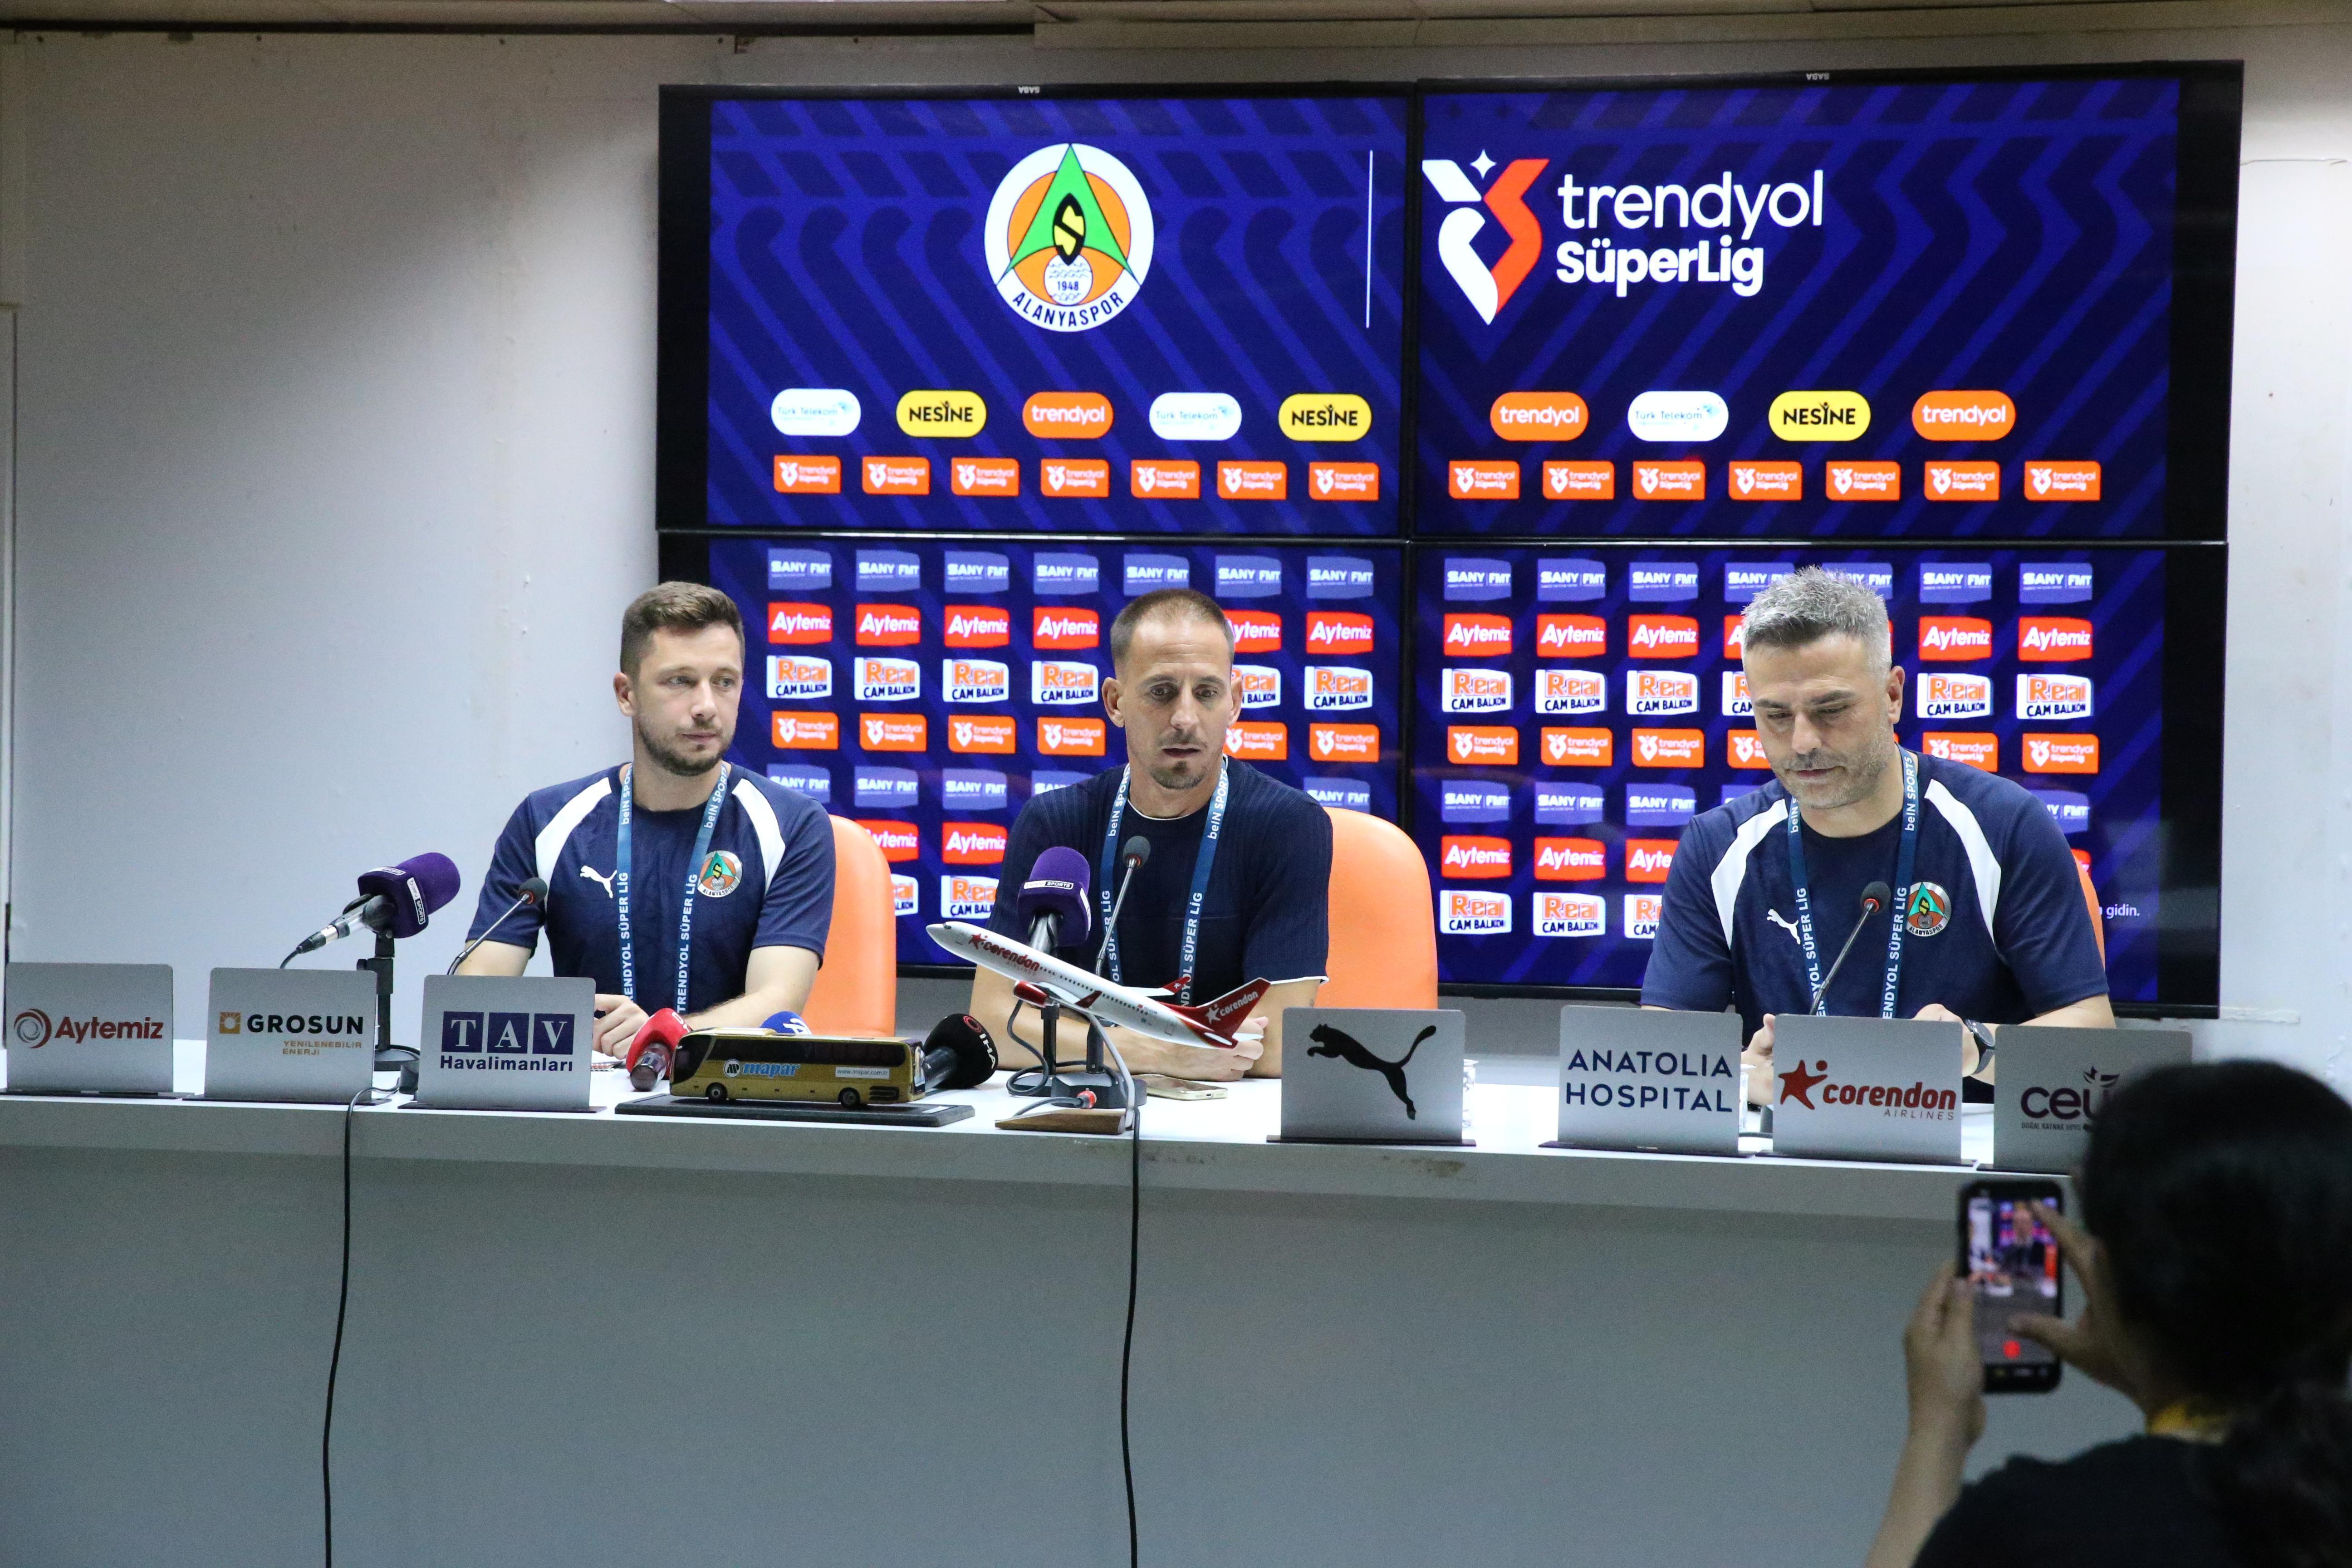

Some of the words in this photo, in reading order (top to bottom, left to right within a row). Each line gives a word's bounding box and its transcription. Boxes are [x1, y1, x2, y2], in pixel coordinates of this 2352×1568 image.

[1558, 170, 1823, 242] trendyol
[1556, 234, 1764, 297] SüperLig
[1057, 281, 1079, 291] 1948
[1012, 292, 1124, 327] ALANYASPOR
[801, 407, 838, 415] Telekom
[1031, 405, 1104, 425] trendyol
[1180, 411, 1218, 420] Telekom
[1500, 406, 1579, 427] trendyol
[1661, 411, 1702, 419] Telekom
[1922, 404, 2006, 426] trendyol
[771, 561, 807, 572] SANY
[859, 562, 894, 573] SANY
[948, 564, 983, 575] SANY
[1037, 565, 1073, 577] SANY
[1219, 568, 1255, 579] SANY
[1310, 569, 1347, 580] SANY
[1448, 571, 1485, 585] SANY
[1541, 571, 1578, 583] SANY
[1632, 572, 1671, 586] SANY
[1923, 573, 1963, 587] SANY
[2023, 573, 2063, 584] SANY
[772, 612, 830, 634] Aytemiz
[859, 613, 918, 636] Aytemiz
[948, 615, 1007, 637] Aytemiz
[1037, 617, 1097, 639] Aytemiz
[1310, 621, 1372, 644] Aytemiz
[1447, 623, 1510, 646] Aytemiz
[1541, 624, 1604, 647] Aytemiz
[1632, 624, 1696, 648] Aytemiz
[1923, 626, 1989, 650] Aytemiz
[2023, 627, 2090, 651] Aytemiz
[776, 685, 797, 696] CAM
[864, 687, 885, 699] CAM
[952, 689, 973, 700] CAM
[1041, 691, 1063, 702] CAM
[1314, 696, 1336, 708] CAM
[1452, 698, 1474, 710] CAM
[1545, 700, 1567, 711] CAM
[1637, 701, 1659, 712] CAM
[1927, 704, 1950, 716] CAM
[2027, 705, 2050, 717] CAM
[712, 765, 727, 803] SPORTS
[1215, 768, 1228, 809] SPORTS
[1907, 757, 1918, 801] SPORTS
[617, 872, 628, 893] LİG
[686, 874, 697, 894] LİG
[1796, 888, 1808, 910] LİG
[1894, 887, 1907, 909] LİG
[618, 897, 630, 939] SÜPER
[680, 898, 694, 941] SÜPER
[2106, 903, 2140, 919] gidin.
[1183, 918, 1197, 962] SÜPER
[1190, 892, 1202, 915] LİG
[1450, 919, 1471, 931] CAM
[1543, 922, 1565, 933] CAM
[1799, 914, 1816, 959] SÜPER
[1888, 913, 1905, 961] SÜPER
[983, 941, 1040, 971] corendon
[676, 944, 689, 1014] TRENDYOL
[1220, 990, 1258, 1017] corendon
[54, 1016, 163, 1044] Aytemiz
[247, 1014, 363, 1034] GROSUN
[451, 1019, 567, 1049] TAV
[441, 1054, 573, 1071] Havalimanları
[743, 1063, 800, 1078] mapar
[1568, 1049, 1732, 1077] ANATOLIA
[1567, 1083, 1732, 1112] HOSPITAL
[1823, 1082, 1956, 1110] corendon
[1884, 1110, 1954, 1121] AIRLINES
